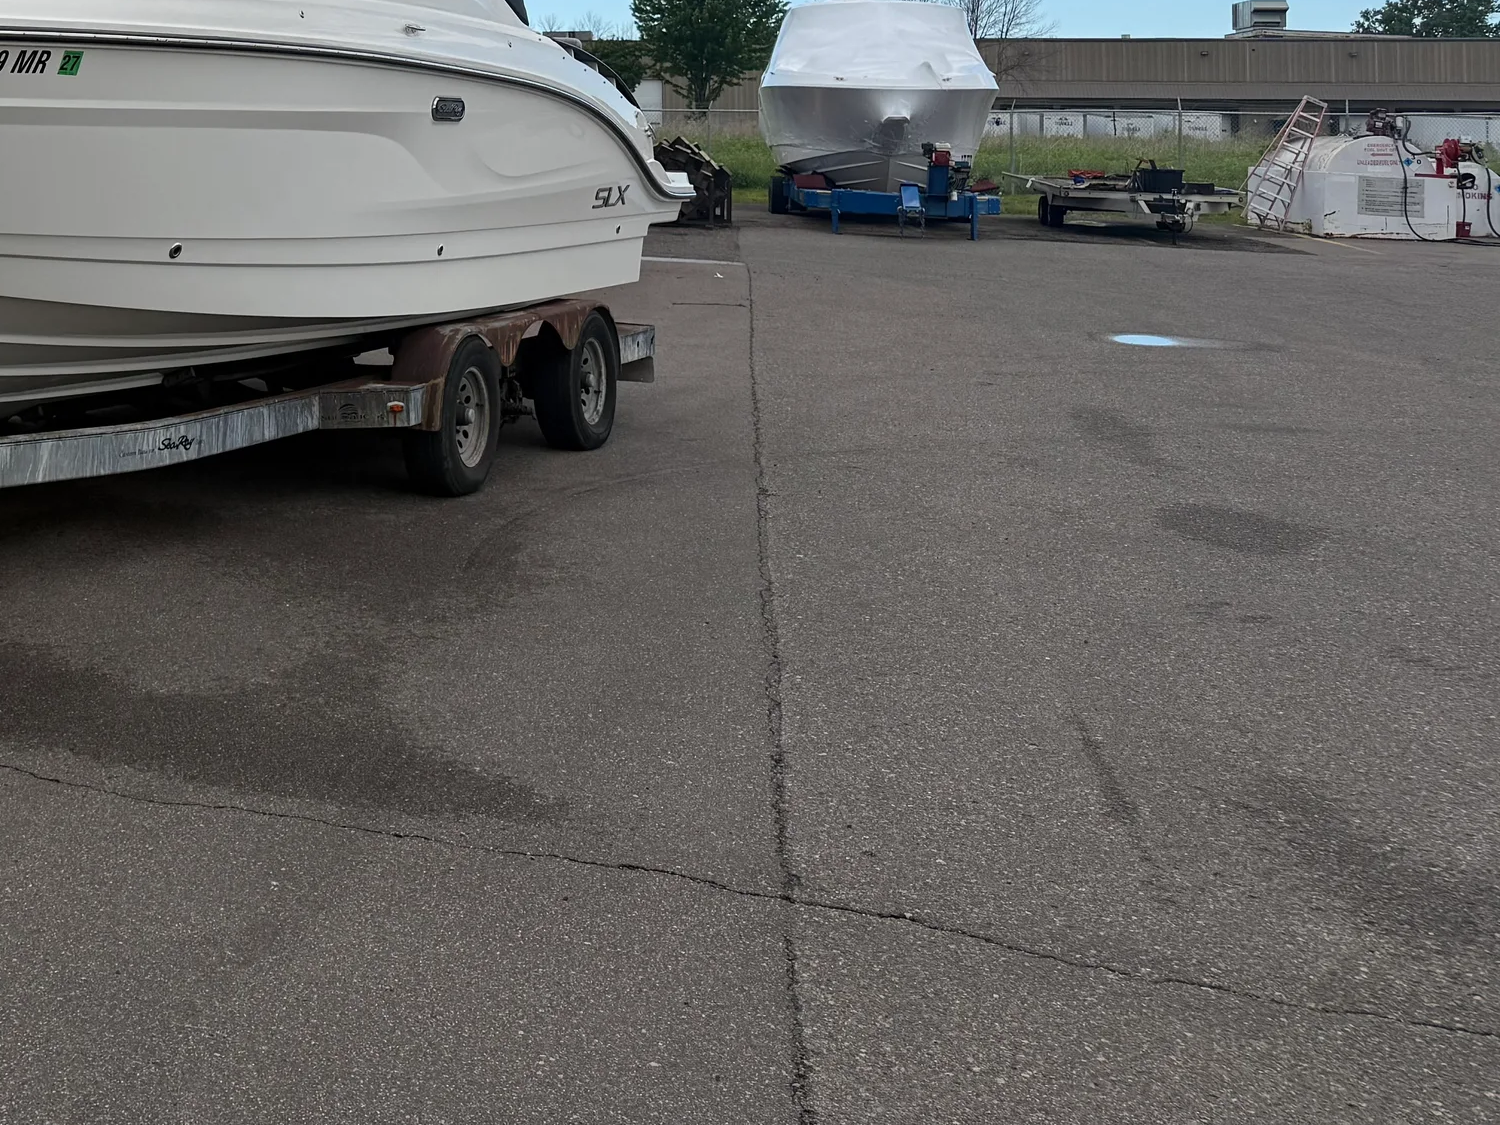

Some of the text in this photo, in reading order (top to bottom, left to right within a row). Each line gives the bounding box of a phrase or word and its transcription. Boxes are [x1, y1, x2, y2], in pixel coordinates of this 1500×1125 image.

[10, 50, 51, 73] MR
[59, 55, 80, 72] 27
[592, 184, 631, 209] SLX
